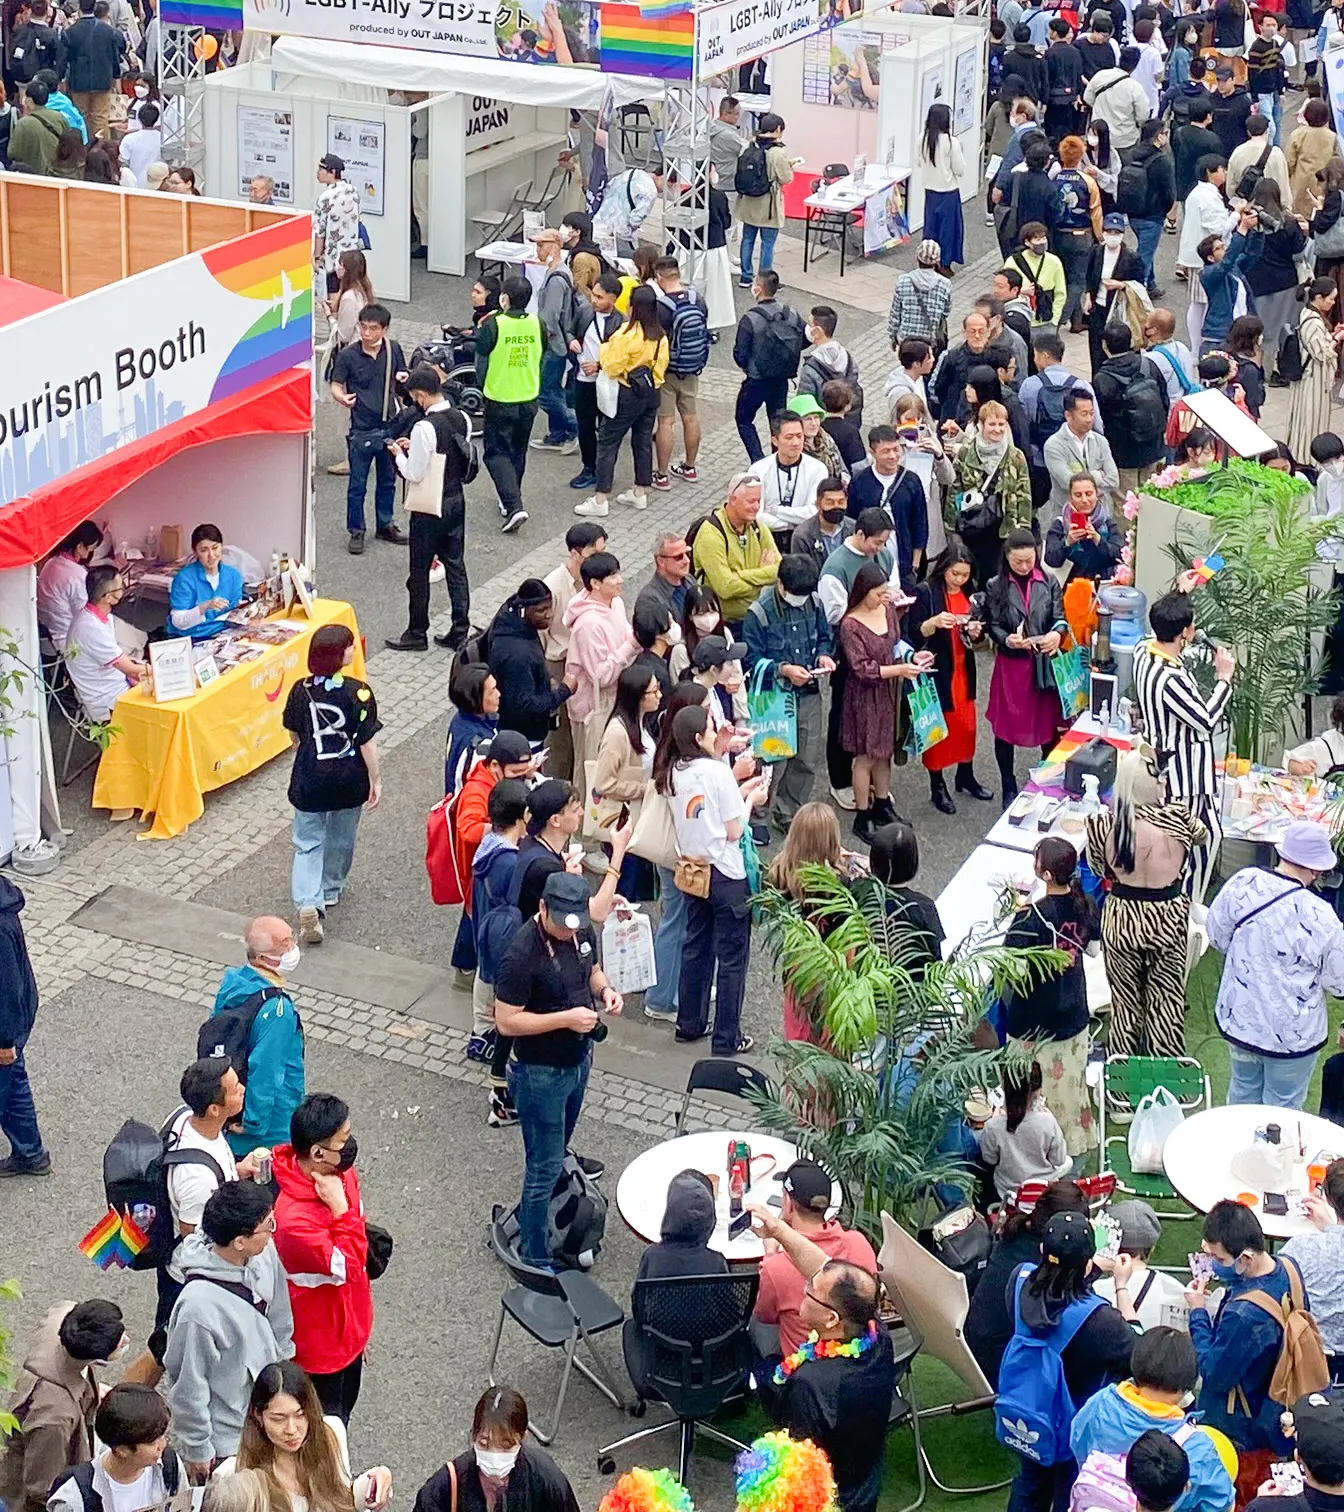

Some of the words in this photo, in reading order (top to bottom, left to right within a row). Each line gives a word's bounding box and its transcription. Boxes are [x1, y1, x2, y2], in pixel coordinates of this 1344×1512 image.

[349, 22, 395, 36] produced
[396, 27, 409, 39] by
[410, 28, 431, 40] OUT
[432, 30, 464, 44] JAPAN
[736, 39, 764, 58] produced
[772, 25, 789, 41] OUT
[789, 17, 810, 35] JAPAN
[704, 46, 725, 62] JAPAN
[465, 107, 509, 137] JAPAN
[505, 335, 536, 345] PRESS
[113, 319, 207, 389] Booth
[750, 719, 790, 734] GUAM
[1003, 1435, 1041, 1461] adidas
